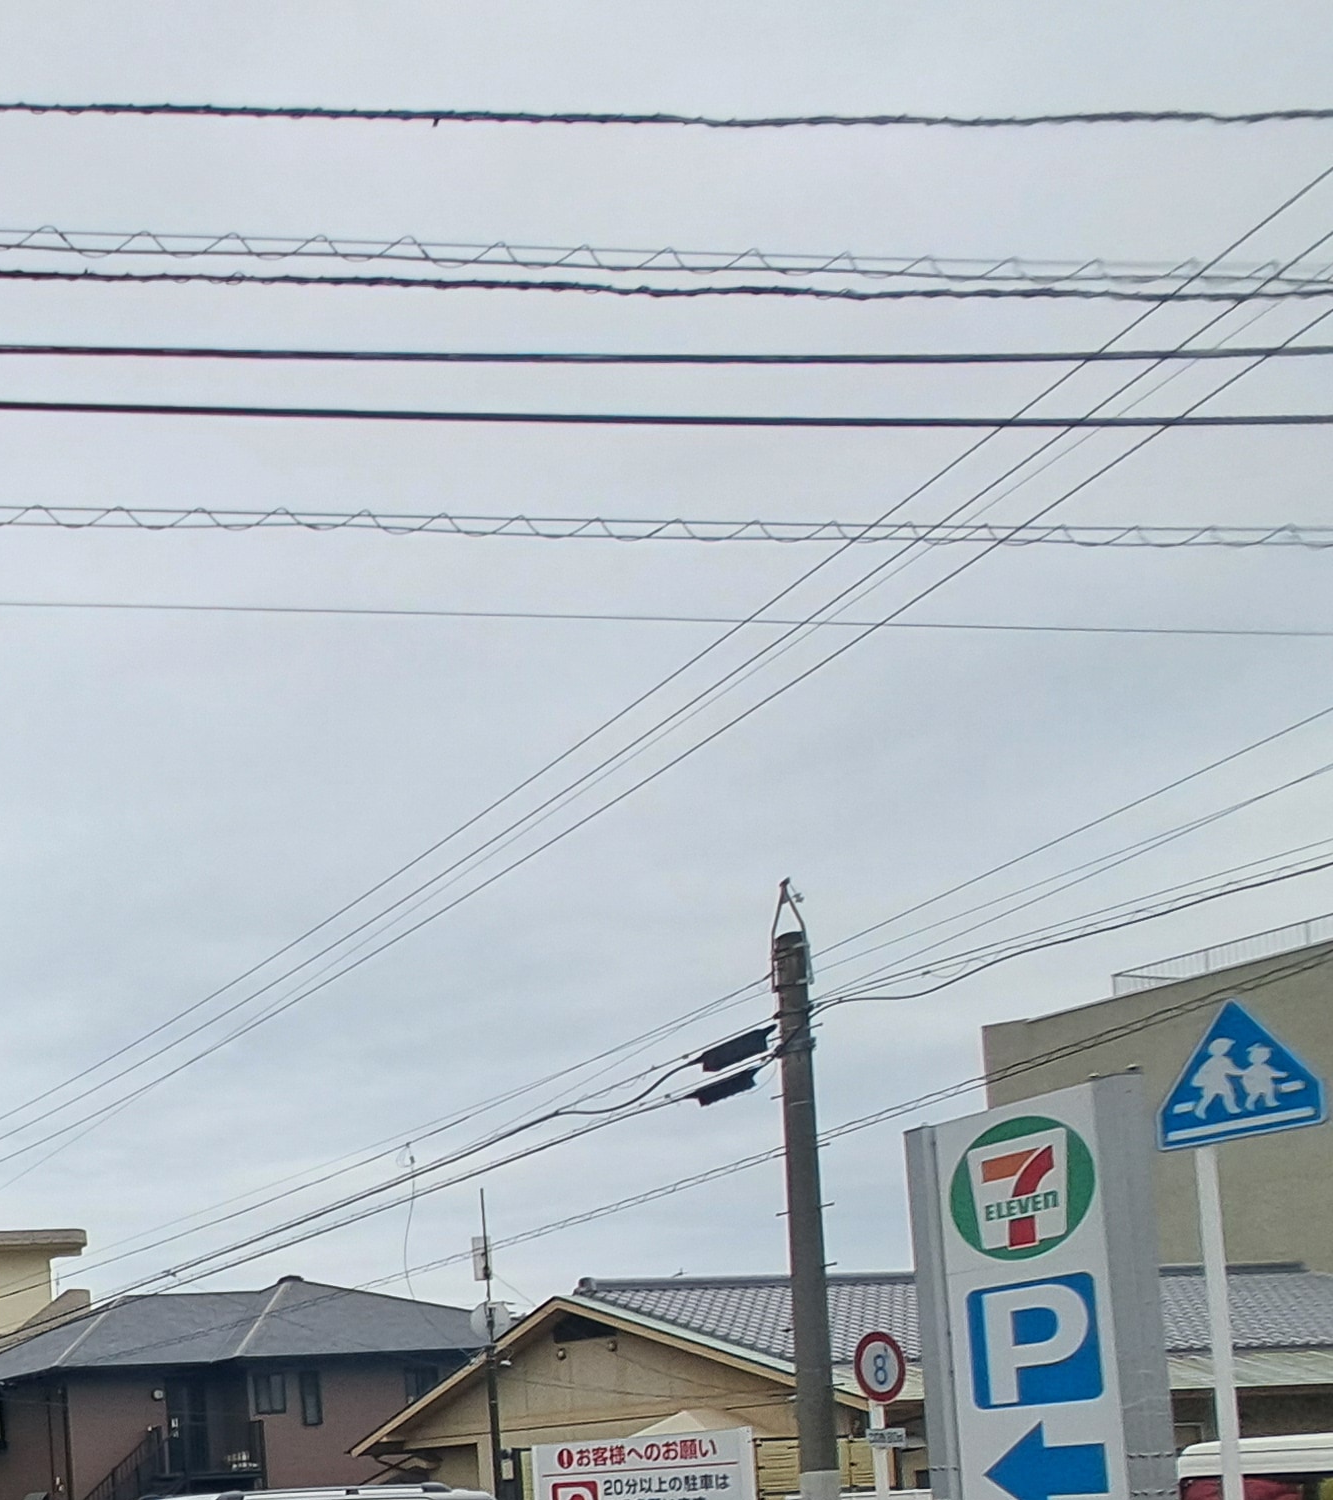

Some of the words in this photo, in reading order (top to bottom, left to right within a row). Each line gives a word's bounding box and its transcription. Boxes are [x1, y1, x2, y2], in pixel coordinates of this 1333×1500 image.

[982, 1283, 1089, 1406] P
[576, 1438, 717, 1469] お客様へのお願い
[603, 1474, 730, 1496] 20分以上の駐車は
